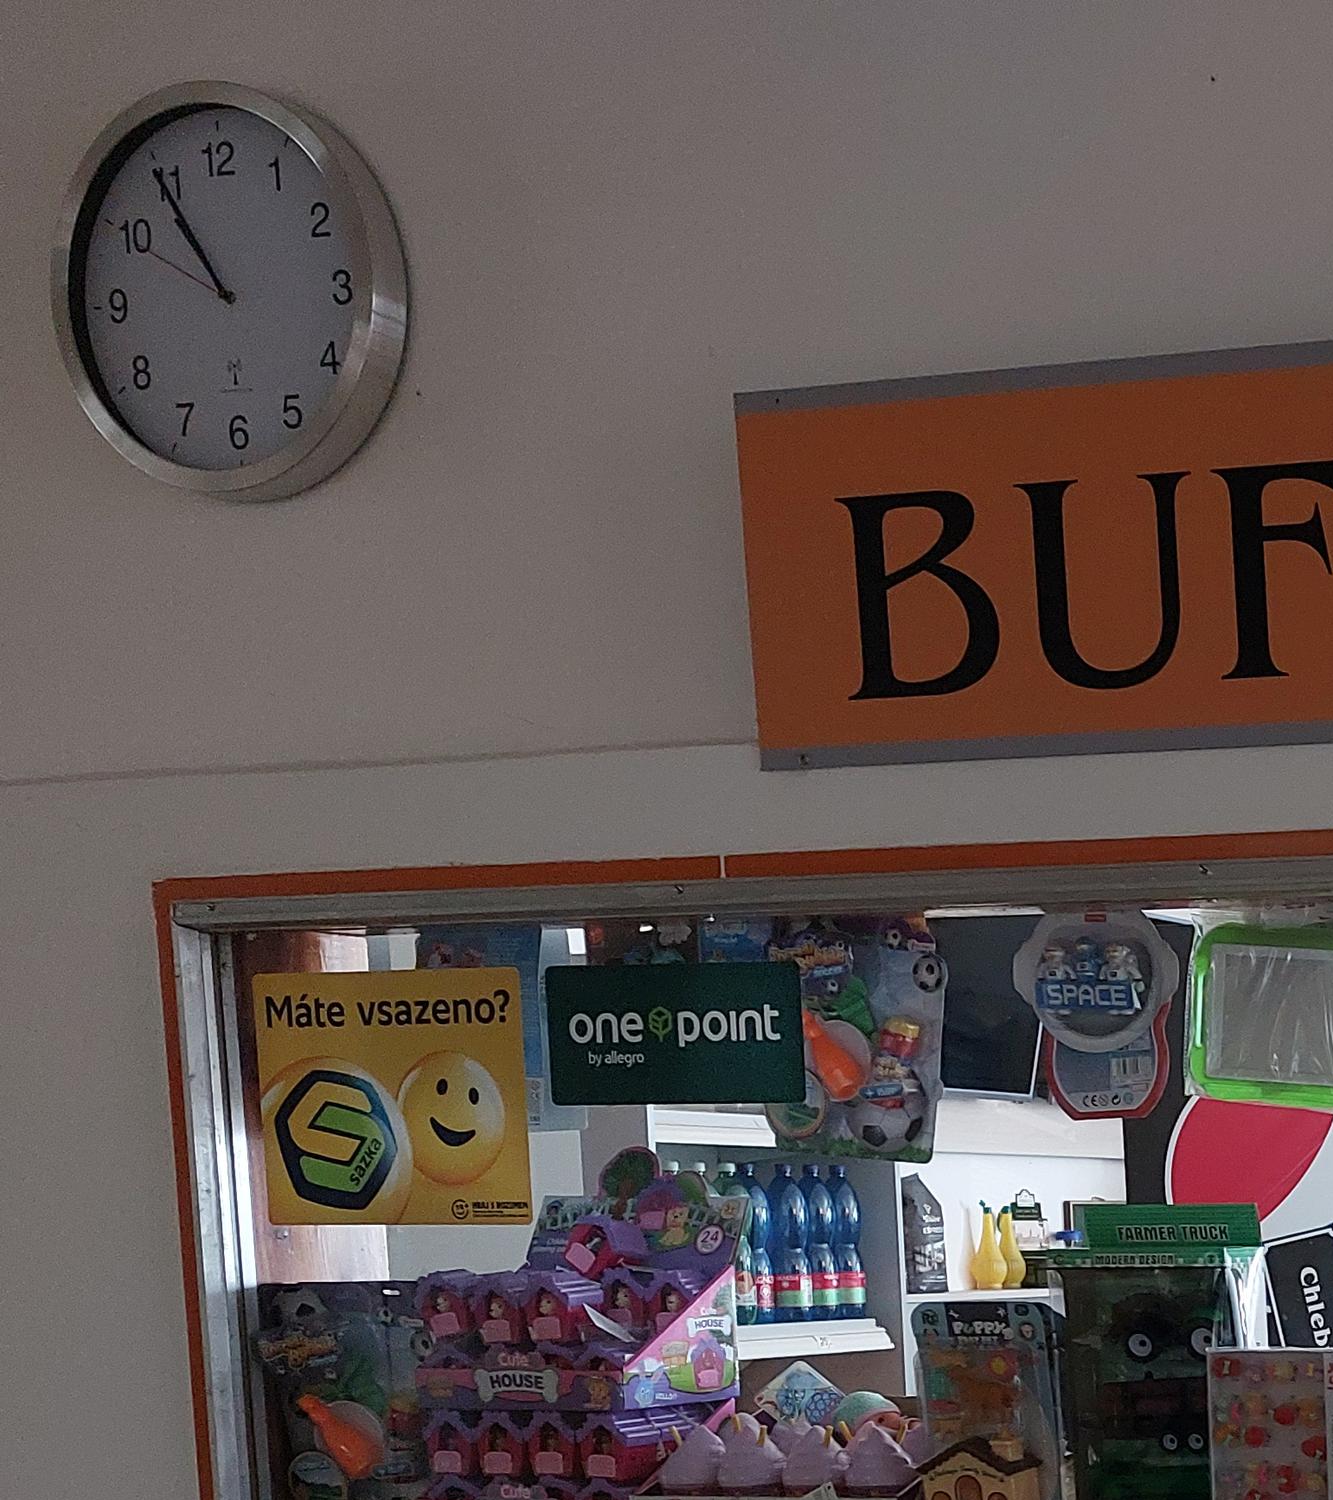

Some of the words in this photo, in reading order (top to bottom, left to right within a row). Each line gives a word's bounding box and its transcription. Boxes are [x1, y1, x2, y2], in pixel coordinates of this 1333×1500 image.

[201, 140, 236, 178] 12
[268, 156, 281, 191] 1
[119, 218, 151, 254] 10
[310, 202, 331, 238] 2
[332, 269, 353, 306] 3
[108, 288, 129, 324] 9
[131, 355, 152, 391] 8
[319, 340, 342, 376] 4
[175, 402, 196, 438] 7
[282, 394, 304, 430] 5
[228, 414, 250, 451] 6
[265, 989, 346, 1029] Máte
[356, 988, 512, 1028] vsazeno?
[1046, 984, 1128, 1007] SPACE
[568, 1009, 644, 1045] one
[677, 1003, 782, 1048] point
[587, 1051, 602, 1067] by
[604, 1049, 645, 1067] allegro
[701, 1229, 721, 1245] 24
[1116, 1225, 1178, 1242] FARMER
[1181, 1223, 1230, 1241] TRUCK
[694, 1317, 726, 1330] HOUSE
[488, 1373, 545, 1391] HOUSE
